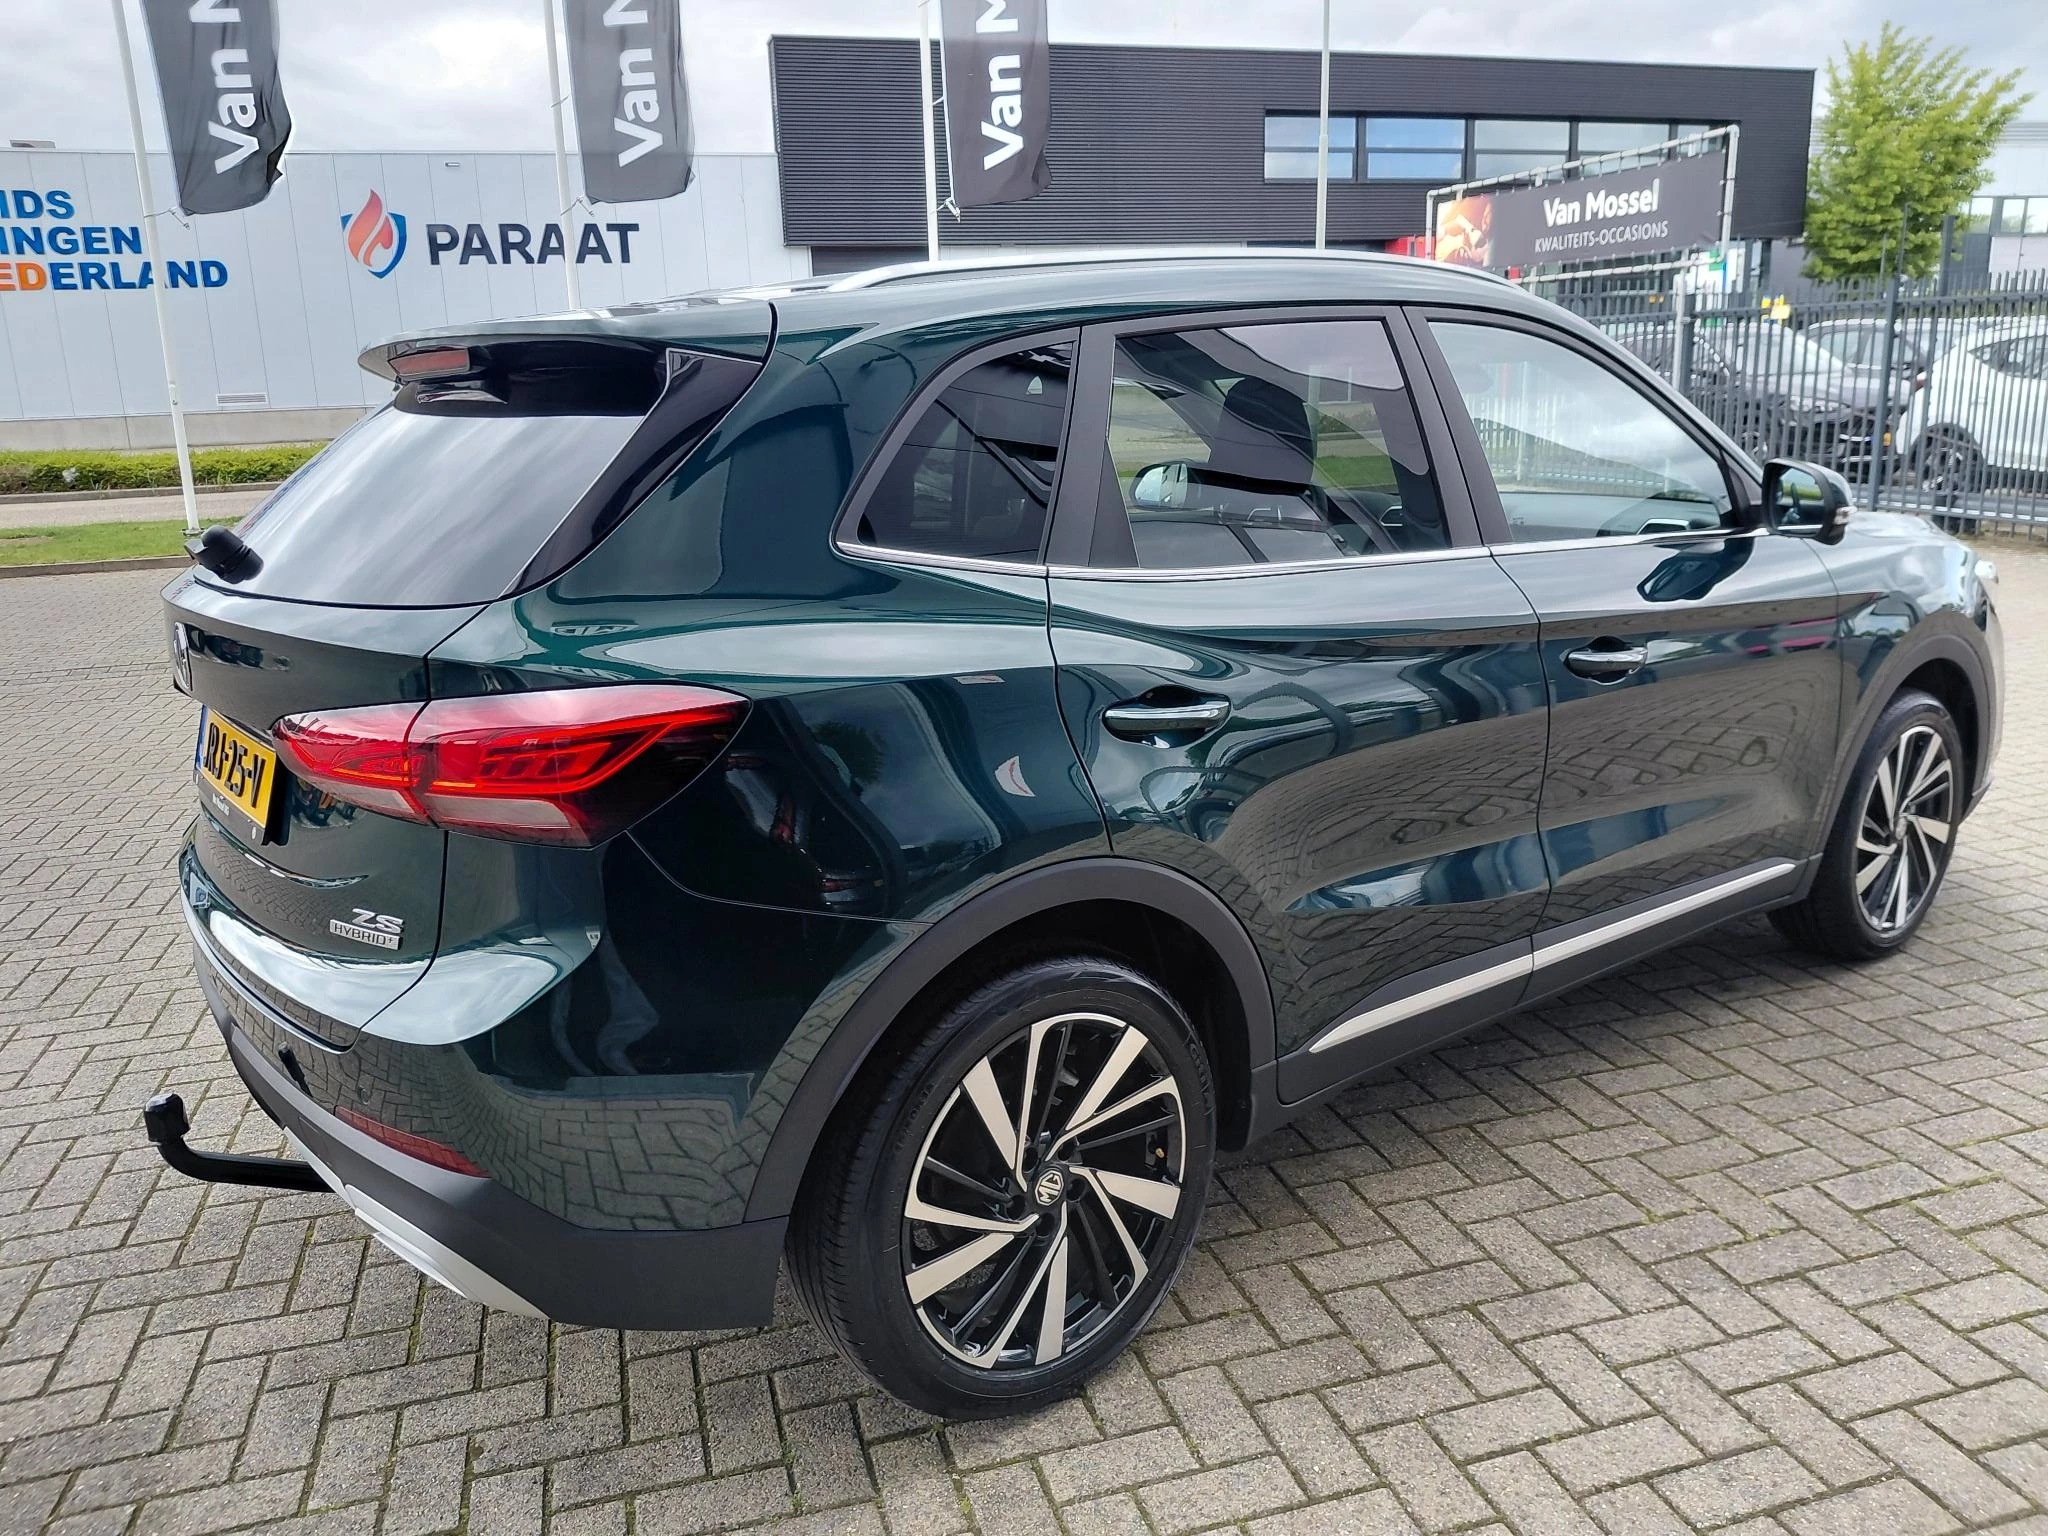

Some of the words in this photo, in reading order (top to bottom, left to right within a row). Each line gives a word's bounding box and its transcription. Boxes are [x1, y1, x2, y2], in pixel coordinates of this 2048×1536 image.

[207, 48, 260, 175] Van
[613, 47, 664, 168] Van
[980, 54, 1024, 171] Van
[1543, 196, 1581, 228] Van
[1584, 178, 1660, 222] Mossel
[0, 226, 142, 255] INGEN
[426, 223, 640, 265] PARAAT
[1534, 220, 1669, 253] KWALITEITS-OCCASIONS
[352, 908, 404, 934] ZS
[1038, 1172, 1063, 1204] MG
